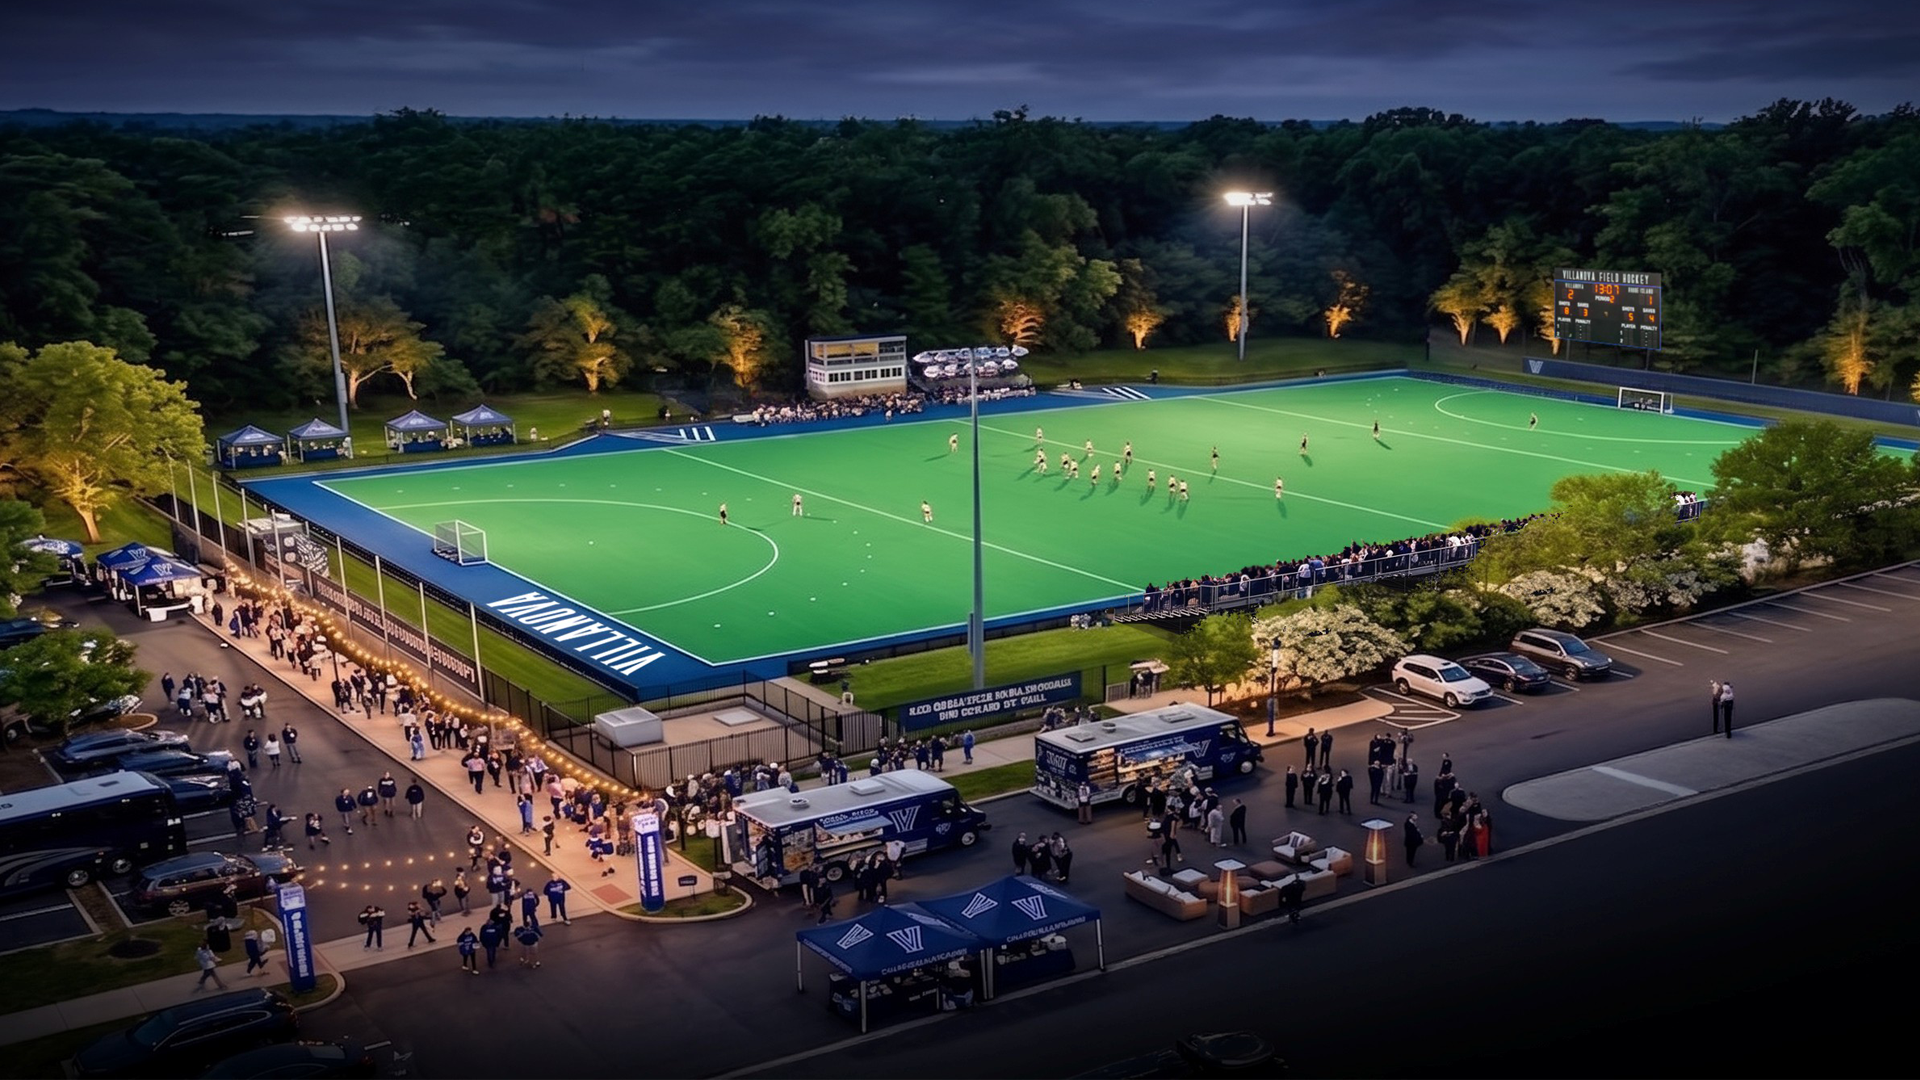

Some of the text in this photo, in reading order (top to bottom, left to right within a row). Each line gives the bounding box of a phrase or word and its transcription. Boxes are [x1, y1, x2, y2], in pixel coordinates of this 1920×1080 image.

[1562, 270, 1649, 285] VILLANOVA FIELD HOCKEY
[1567, 289, 1574, 299] 2
[1594, 284, 1619, 295] 13:07
[486, 591, 666, 676] VILLANOVA
